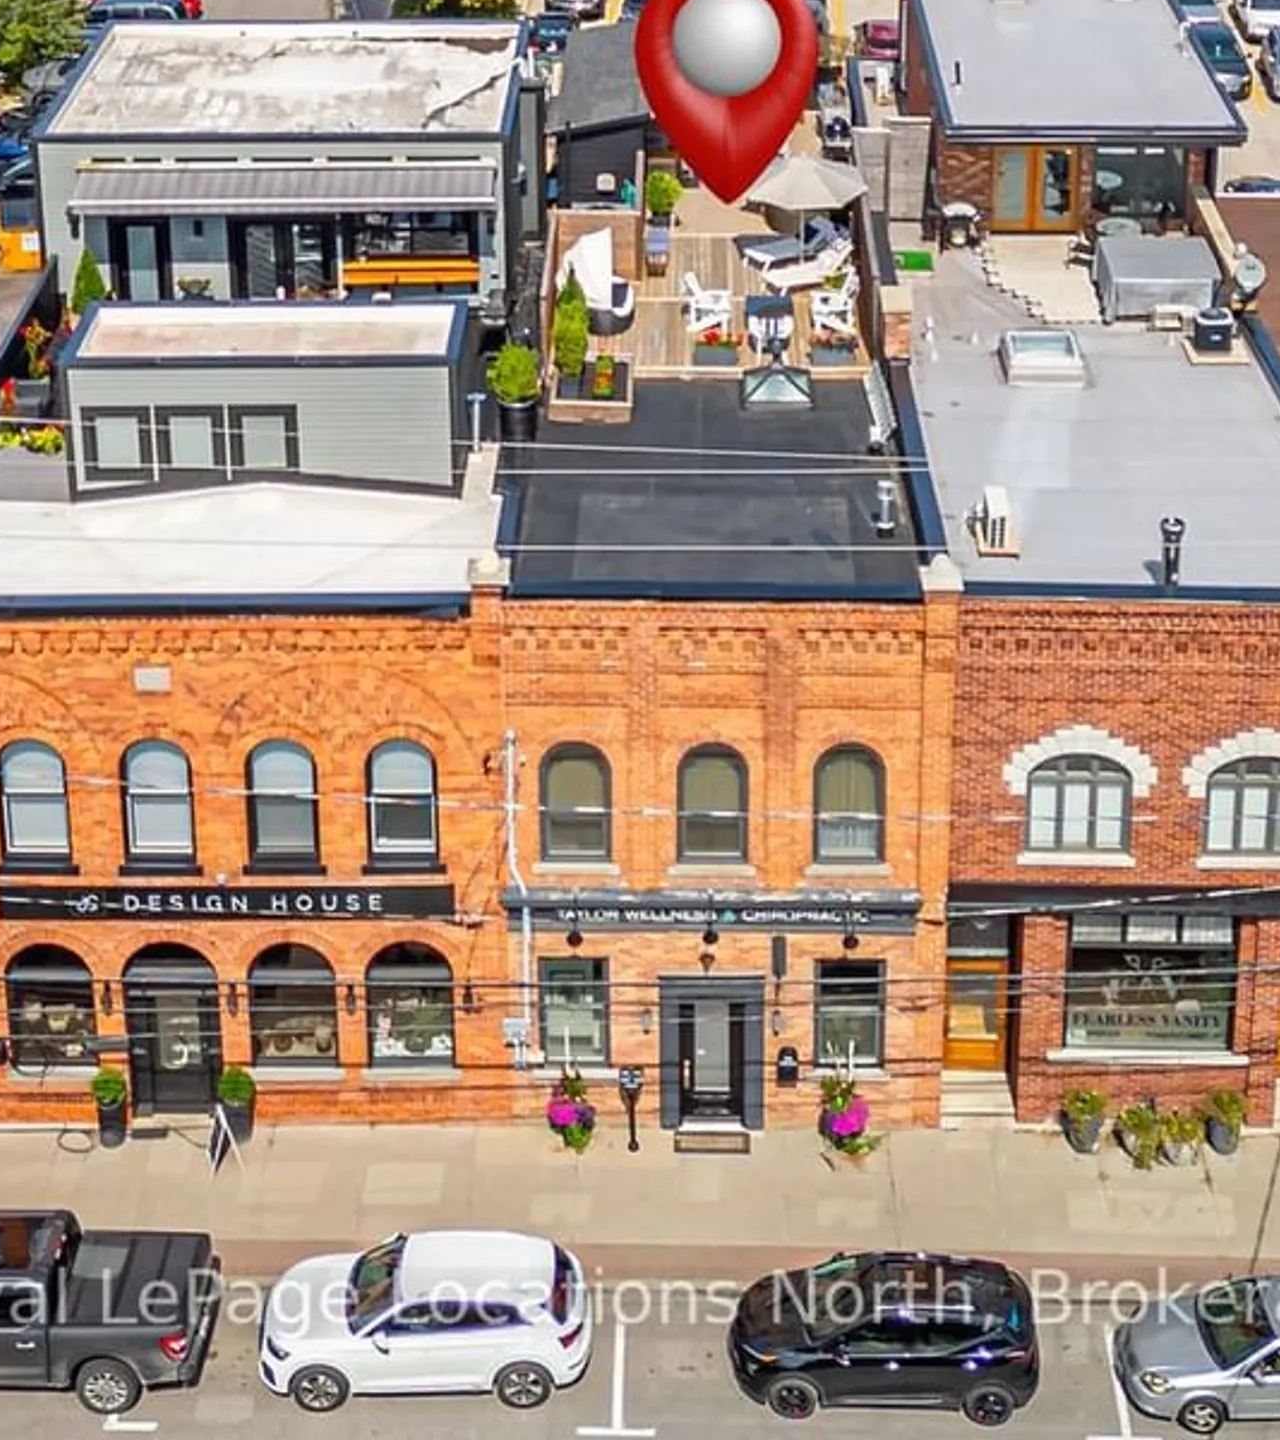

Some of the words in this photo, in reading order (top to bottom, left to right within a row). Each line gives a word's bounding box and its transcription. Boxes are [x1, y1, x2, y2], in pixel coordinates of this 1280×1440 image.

[123, 893, 249, 911] DESIGN
[272, 893, 384, 911] HOUSE
[1072, 1012, 1157, 1027] FEARLESS
[1160, 1013, 1220, 1028] VANITY
